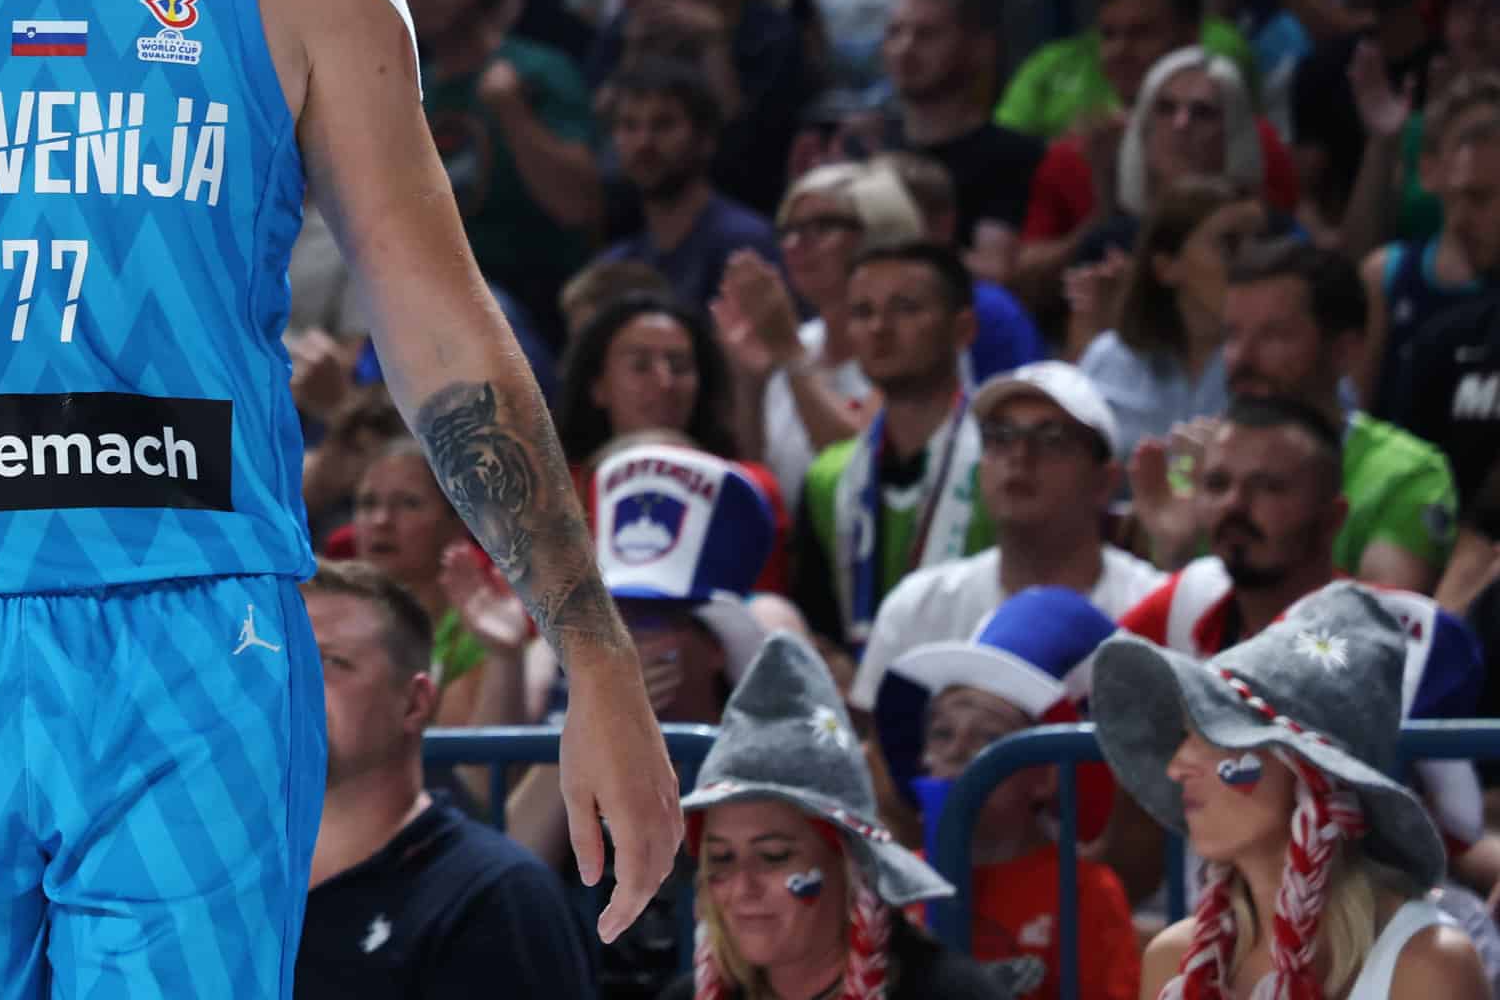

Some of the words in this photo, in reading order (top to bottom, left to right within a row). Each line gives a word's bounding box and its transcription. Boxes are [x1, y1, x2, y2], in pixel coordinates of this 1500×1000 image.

[140, 43, 177, 53] WORLD
[178, 45, 198, 55] CUP
[141, 51, 197, 62] QUALIFIERS
[2, 239, 89, 343] 77
